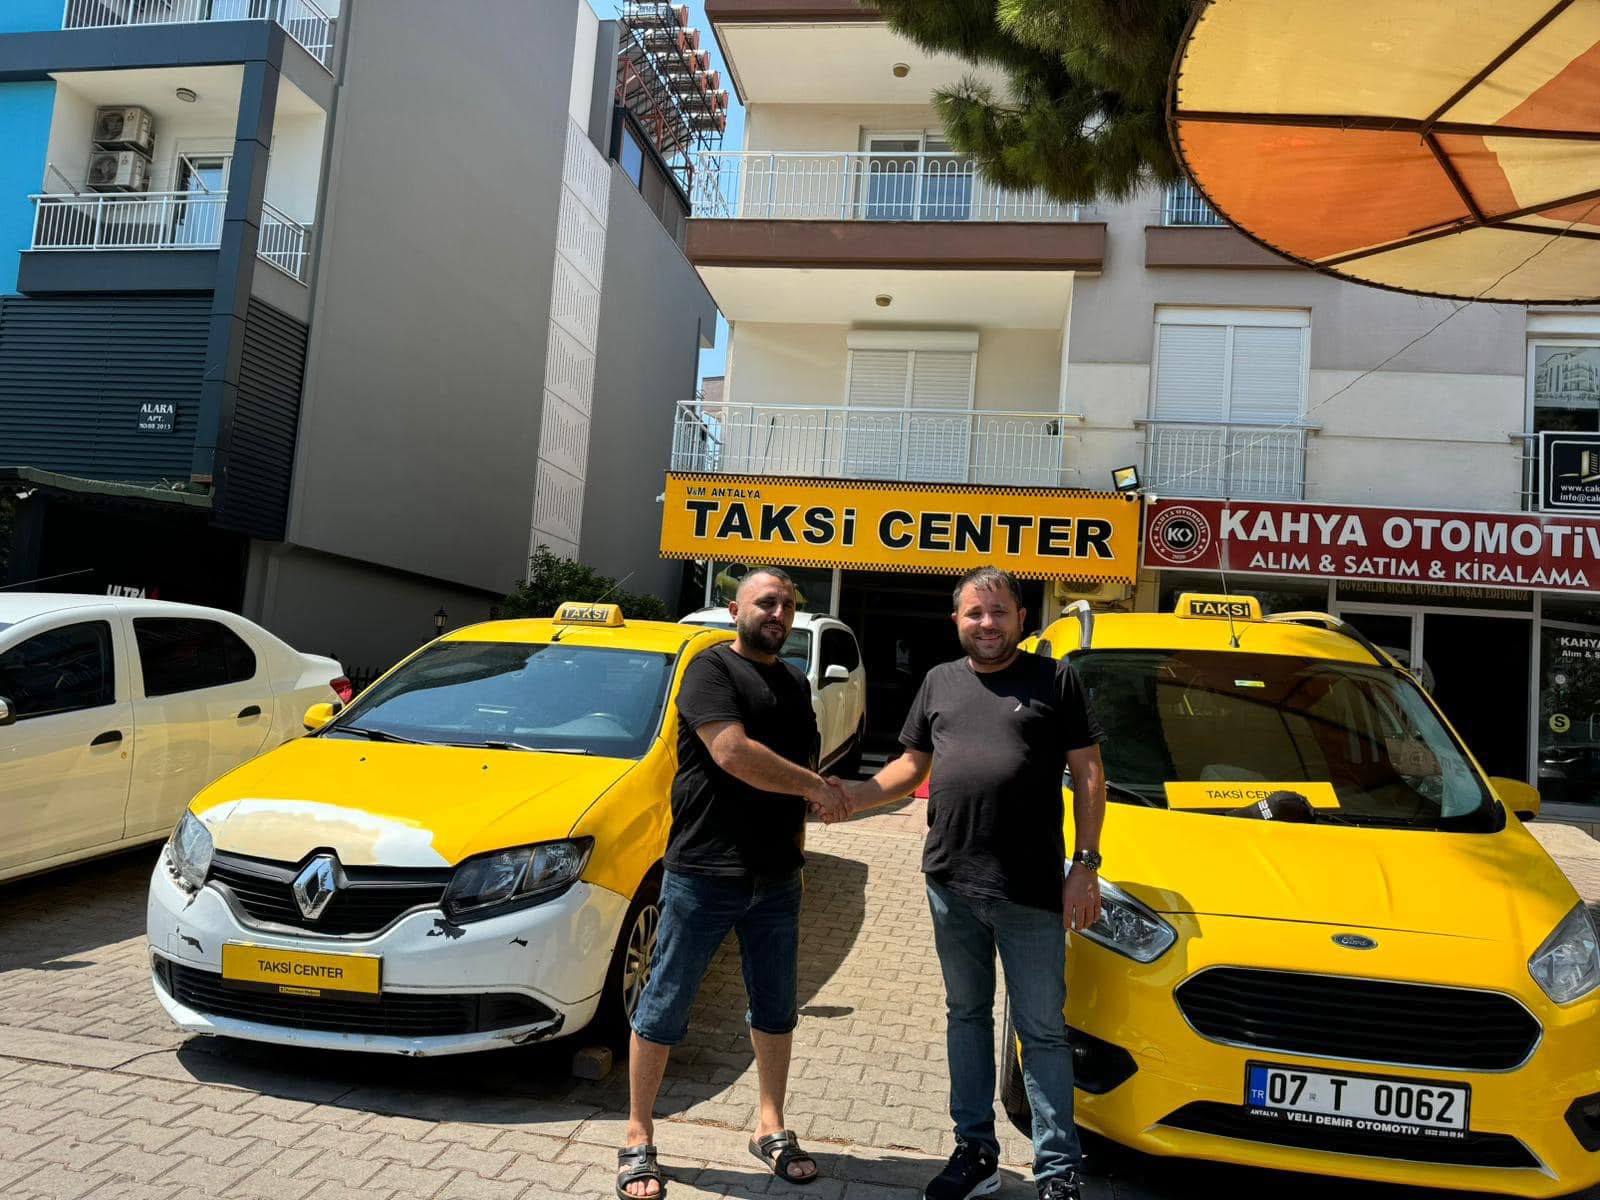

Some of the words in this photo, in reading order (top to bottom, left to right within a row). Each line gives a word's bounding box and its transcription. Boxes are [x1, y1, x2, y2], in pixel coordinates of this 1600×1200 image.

[140, 403, 173, 414] ALARA
[711, 487, 761, 499] ANTALYA
[1219, 508, 1368, 547] KAHYA
[878, 510, 1116, 560] CENTER
[1249, 550, 1310, 571] ALIM
[1318, 553, 1336, 573] &
[1344, 555, 1420, 577] SATIM
[1428, 559, 1446, 580] &
[1454, 557, 1590, 587] KİRALAMA
[1554, 716, 1565, 727] S
[1246, 790, 1276, 800] CEN
[294, 963, 344, 979] CENTER
[1251, 1088, 1264, 1100] TR
[1269, 1072, 1307, 1106] 07
[1330, 1078, 1348, 1112] T
[1374, 1084, 1455, 1124] 0062
[1250, 1108, 1279, 1118] ANTALYA
